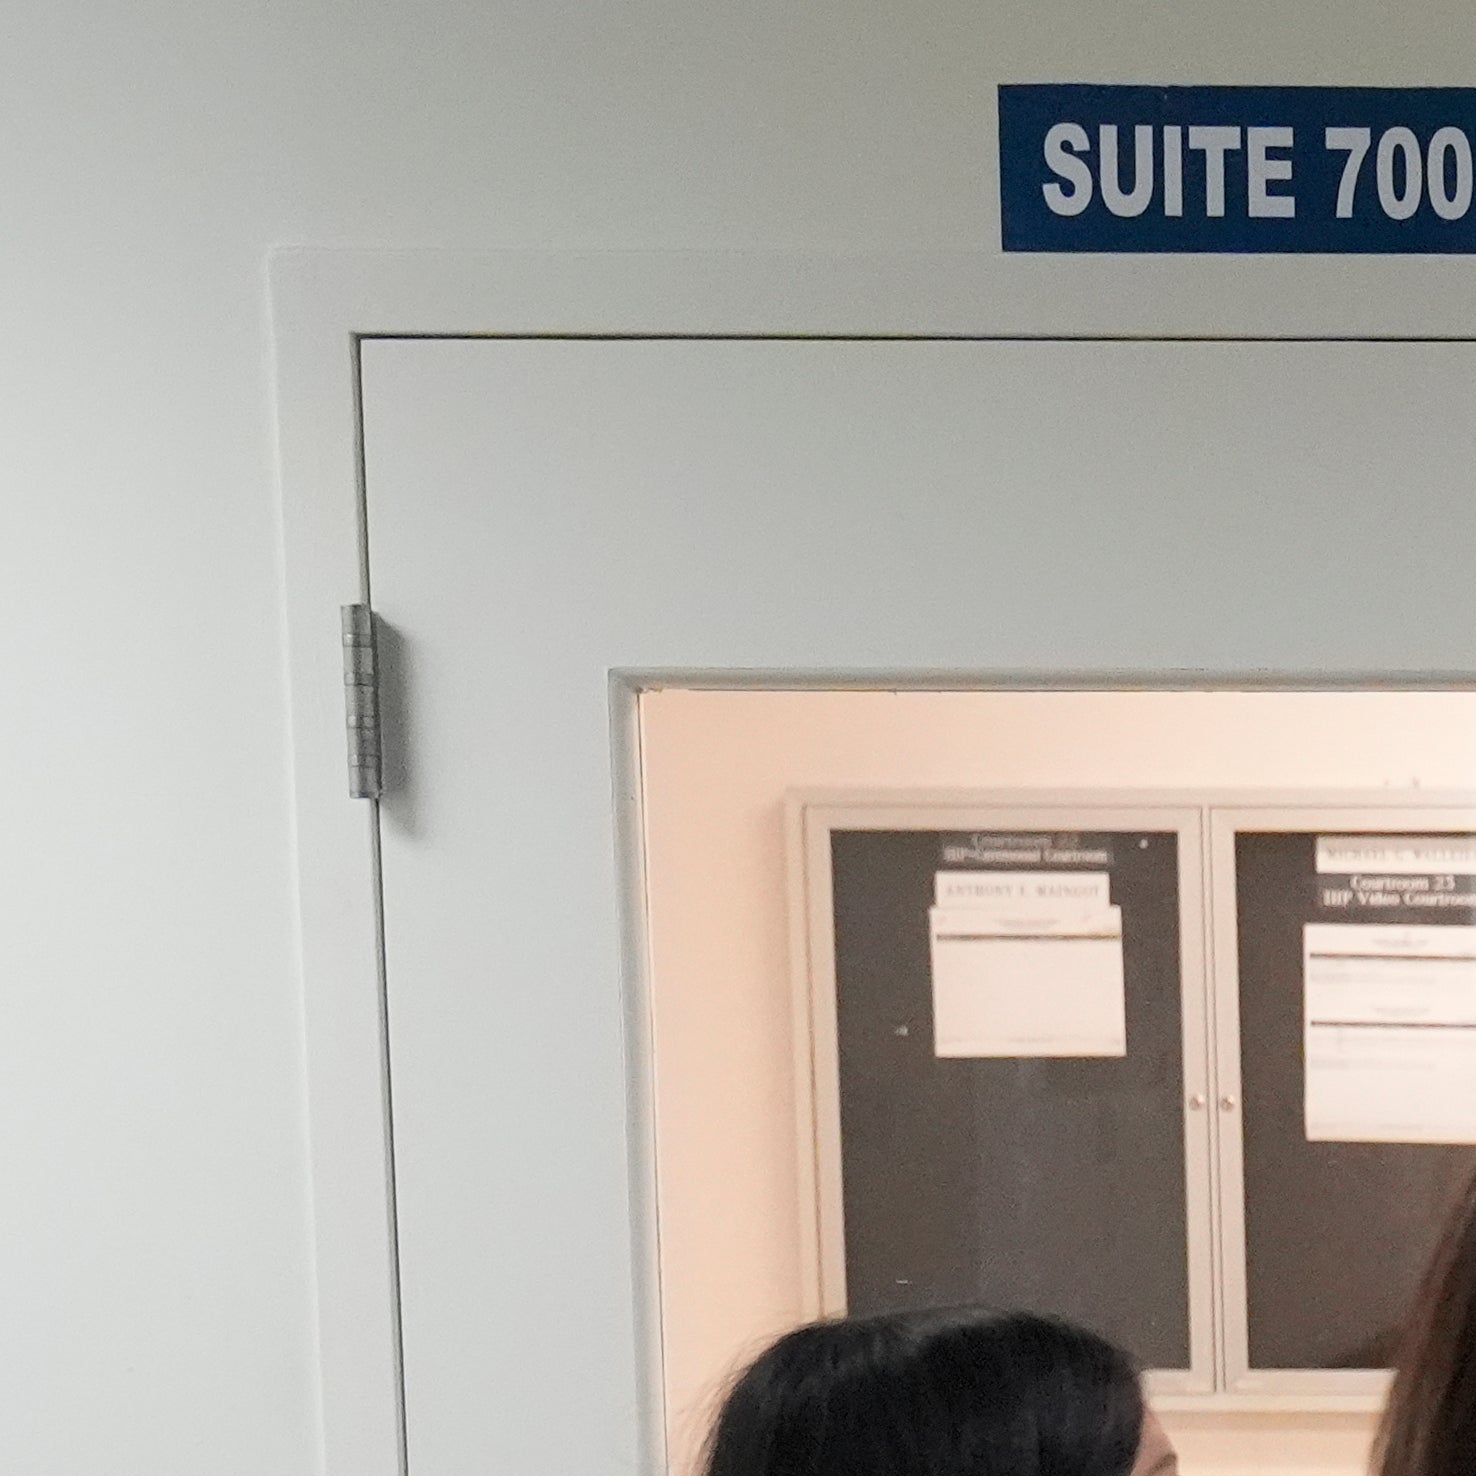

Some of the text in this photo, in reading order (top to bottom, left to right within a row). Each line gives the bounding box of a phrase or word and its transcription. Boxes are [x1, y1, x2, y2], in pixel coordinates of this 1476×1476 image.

[1043, 123, 1294, 217] SUITE
[1326, 128, 1472, 219] 700
[1350, 875, 1429, 891] Courtroom
[1356, 891, 1400, 907] Video
